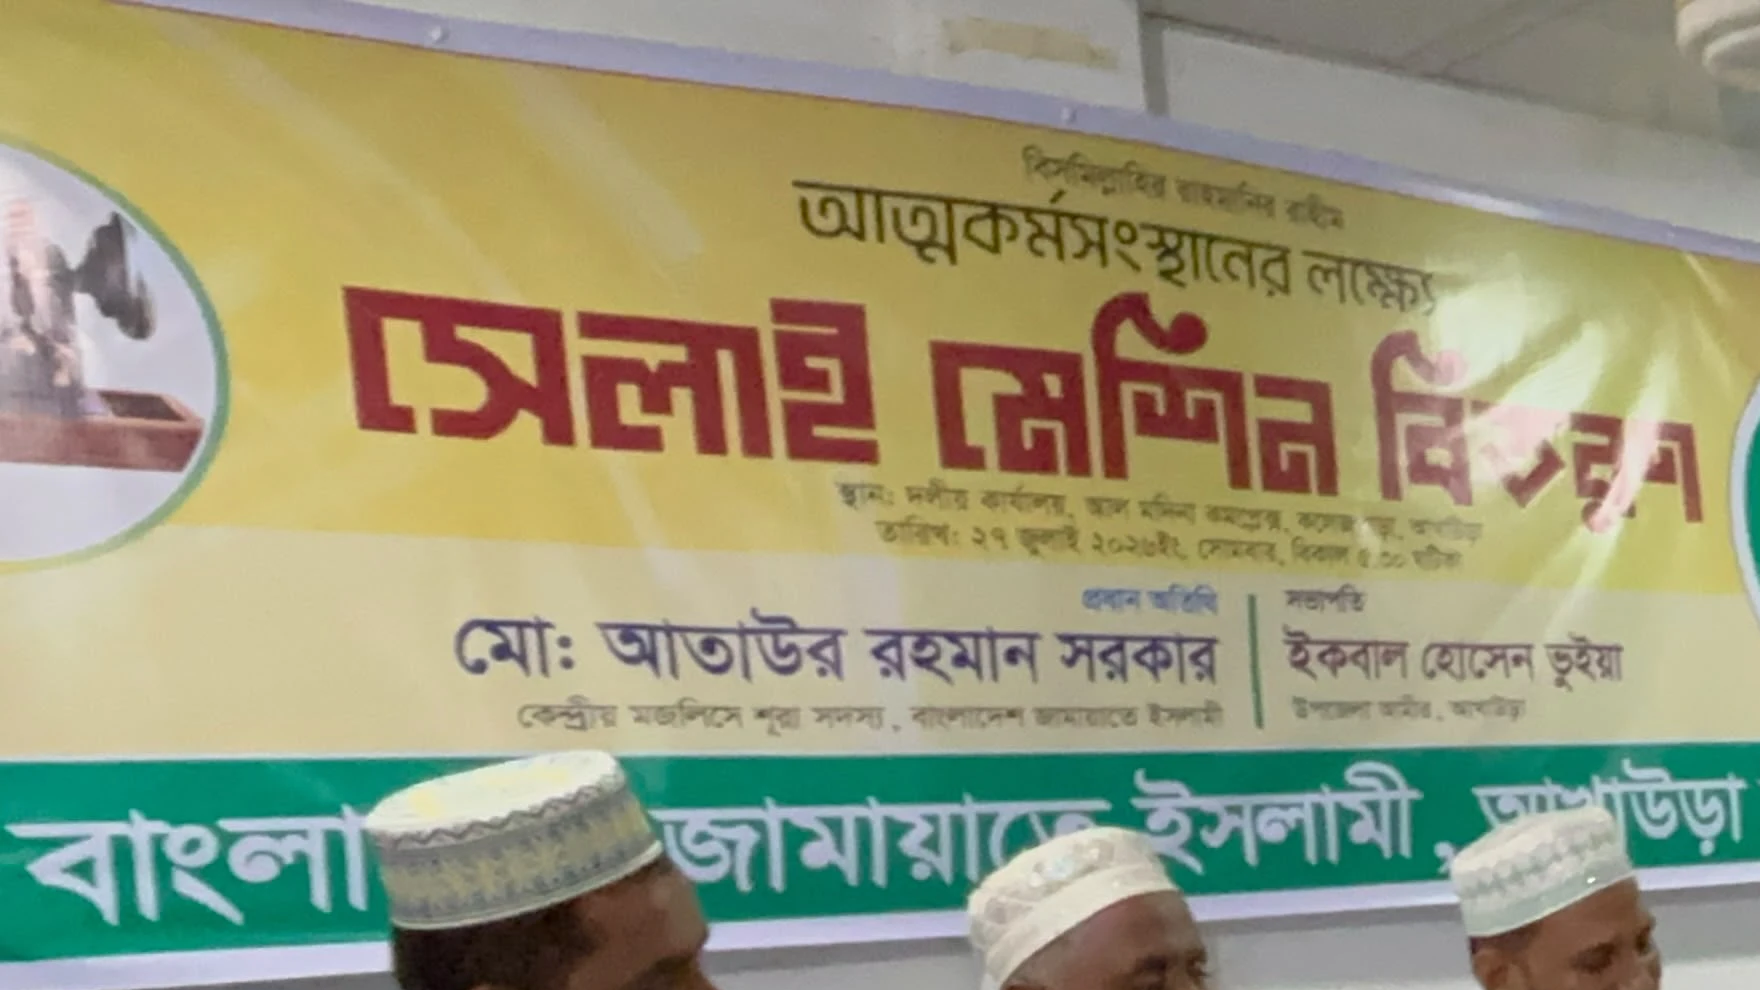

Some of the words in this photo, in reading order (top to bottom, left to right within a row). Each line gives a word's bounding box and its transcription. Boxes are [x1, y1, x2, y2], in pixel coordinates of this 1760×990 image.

[792, 181, 1291, 296] আত্মকর্মসংস্থানের
[1302, 250, 1437, 317] লক্ষ্যে
[342, 286, 880, 464] সেলাই
[929, 292, 1340, 496] মেশিন
[1283, 583, 1366, 613] সভাপতি
[595, 607, 848, 681] আতাউর
[862, 626, 1041, 684] রহমান
[1054, 630, 1220, 685] সরকার
[1282, 623, 1410, 684] ইকবাল
[1421, 639, 1534, 683] হোসেন
[909, 705, 1026, 730] বাংলাদেশ
[5, 803, 371, 925] বাংলা
